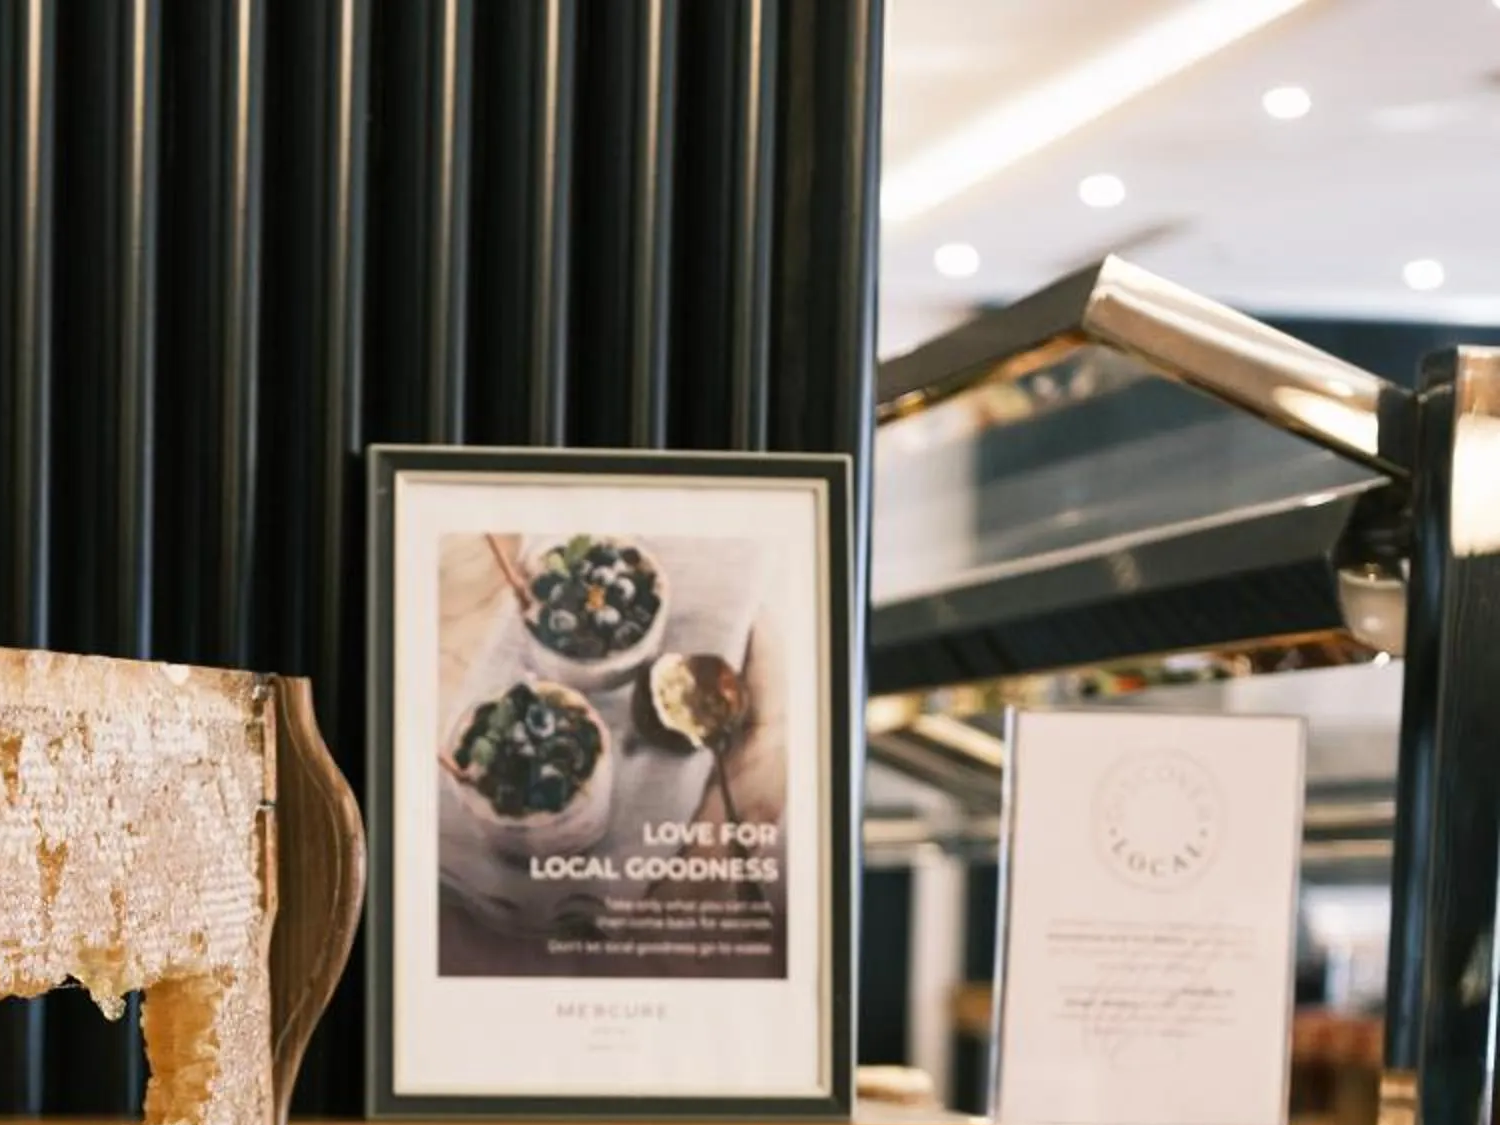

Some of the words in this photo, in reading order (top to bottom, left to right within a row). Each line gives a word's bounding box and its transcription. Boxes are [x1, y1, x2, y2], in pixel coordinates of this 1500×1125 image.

[643, 821, 715, 847] LOVE
[719, 822, 778, 847] FOR
[529, 856, 620, 880] LOCAL
[624, 857, 780, 883] GOODNESS
[1110, 836, 1203, 878] LOCAL
[555, 1001, 667, 1020] MERCURE
